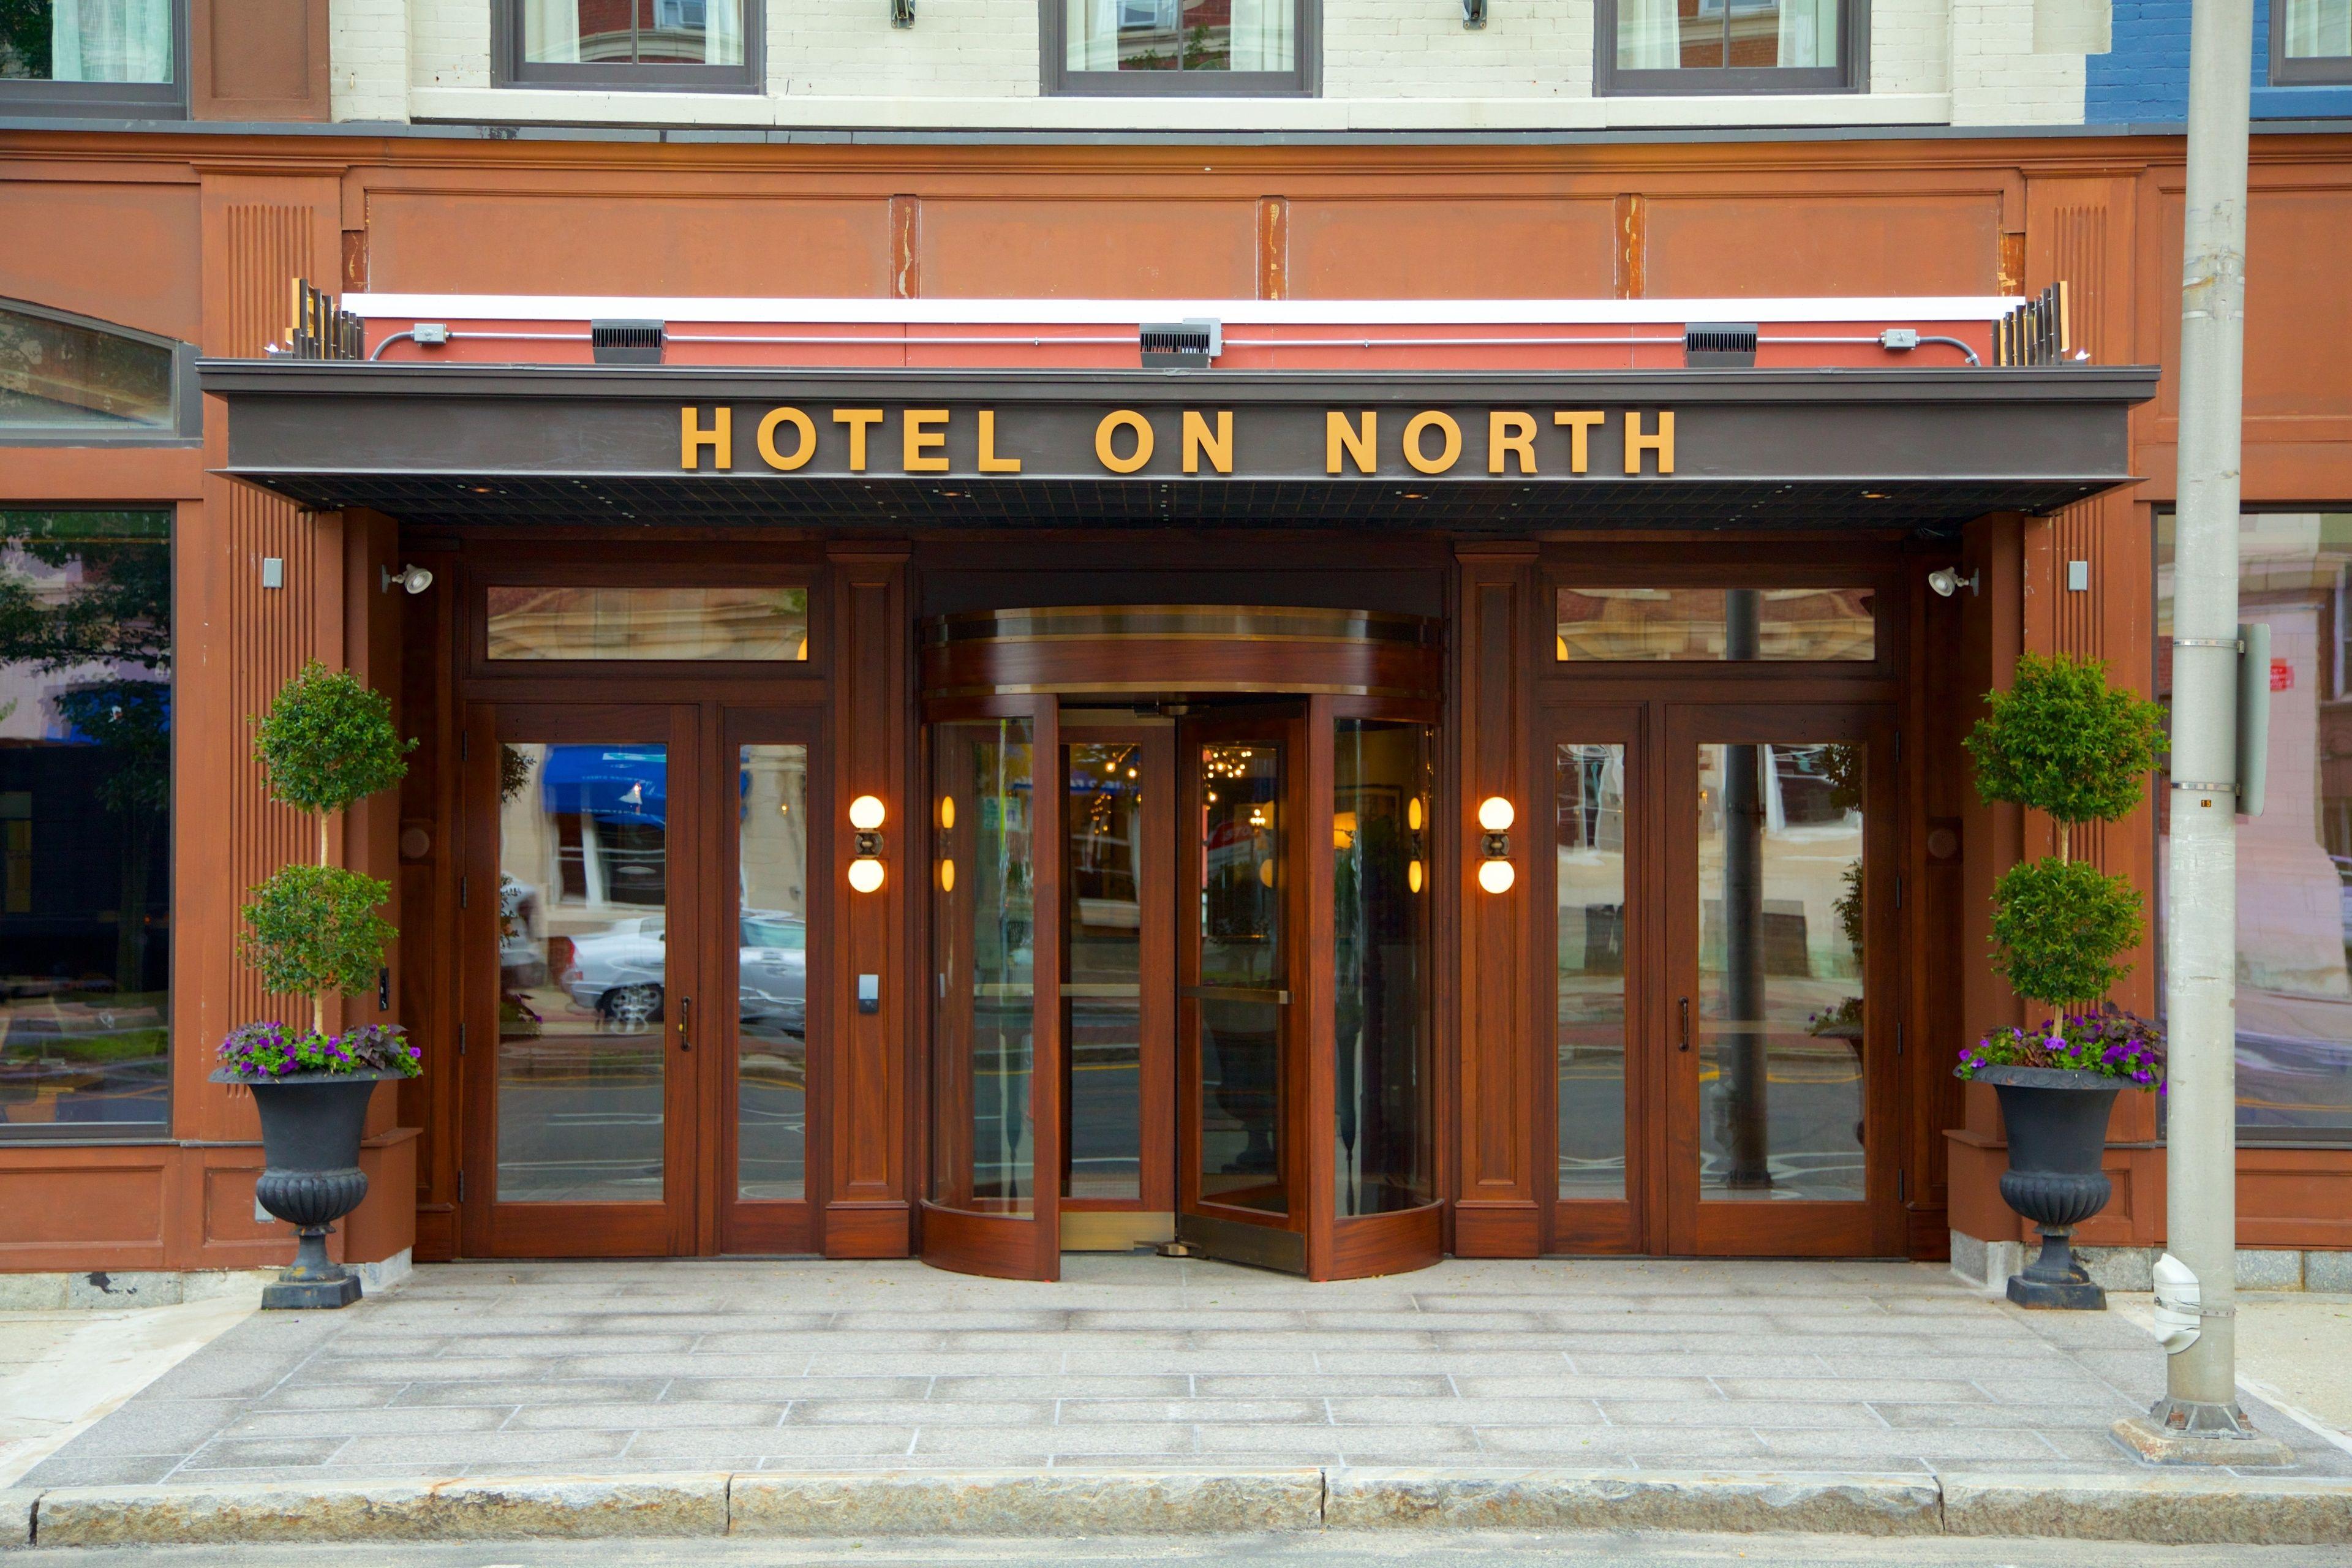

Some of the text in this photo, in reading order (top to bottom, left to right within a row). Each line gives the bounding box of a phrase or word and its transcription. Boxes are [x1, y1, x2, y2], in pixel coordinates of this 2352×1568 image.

[681, 407, 1675, 474] HOTEL ON NORTH
